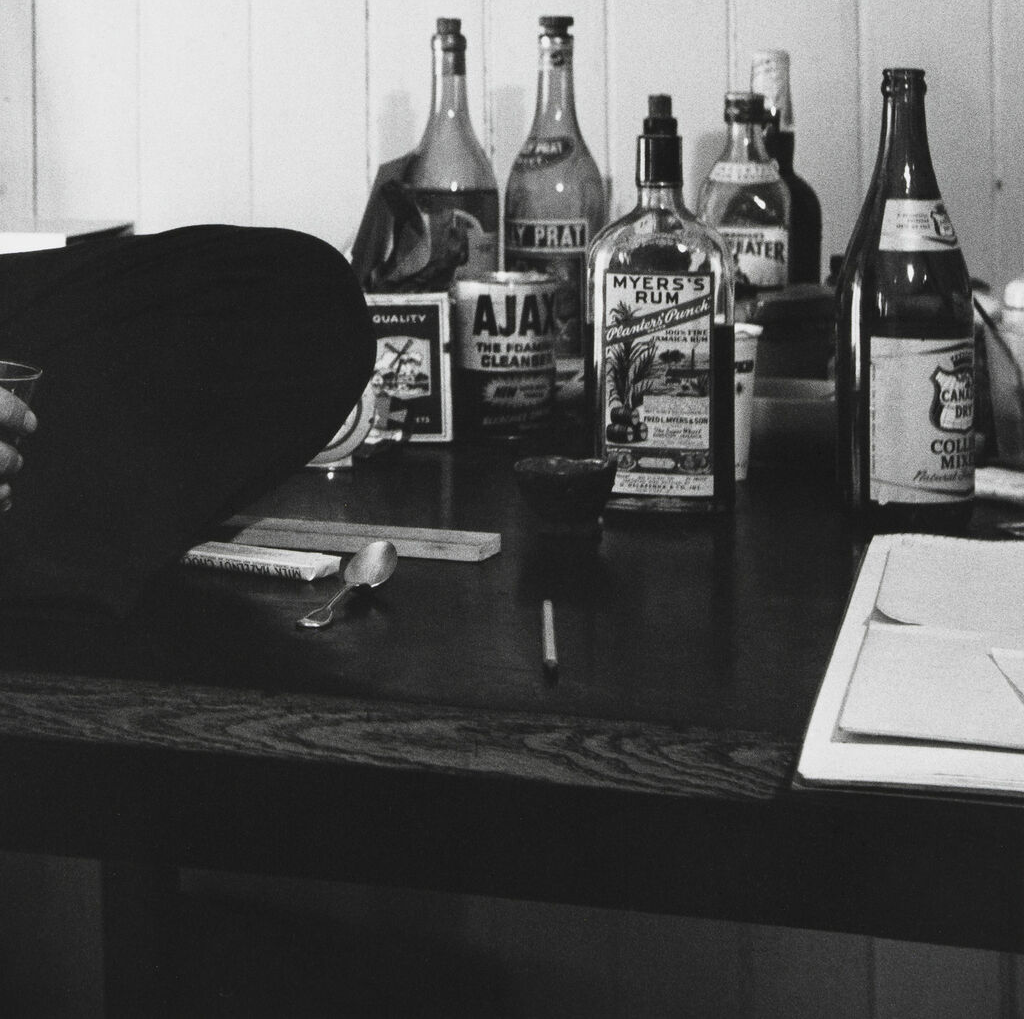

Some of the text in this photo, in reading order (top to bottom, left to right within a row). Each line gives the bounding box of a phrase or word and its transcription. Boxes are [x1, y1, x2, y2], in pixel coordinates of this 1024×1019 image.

[534, 223, 584, 246] PRAT
[612, 275, 706, 292] MYERS'S
[635, 290, 680, 305] RUM
[371, 313, 427, 324] QUALITY
[472, 293, 556, 337] AJAX
[475, 341, 501, 353] THE
[219, 560, 271, 575] HAZELNUT
[274, 567, 302, 579] MILK
